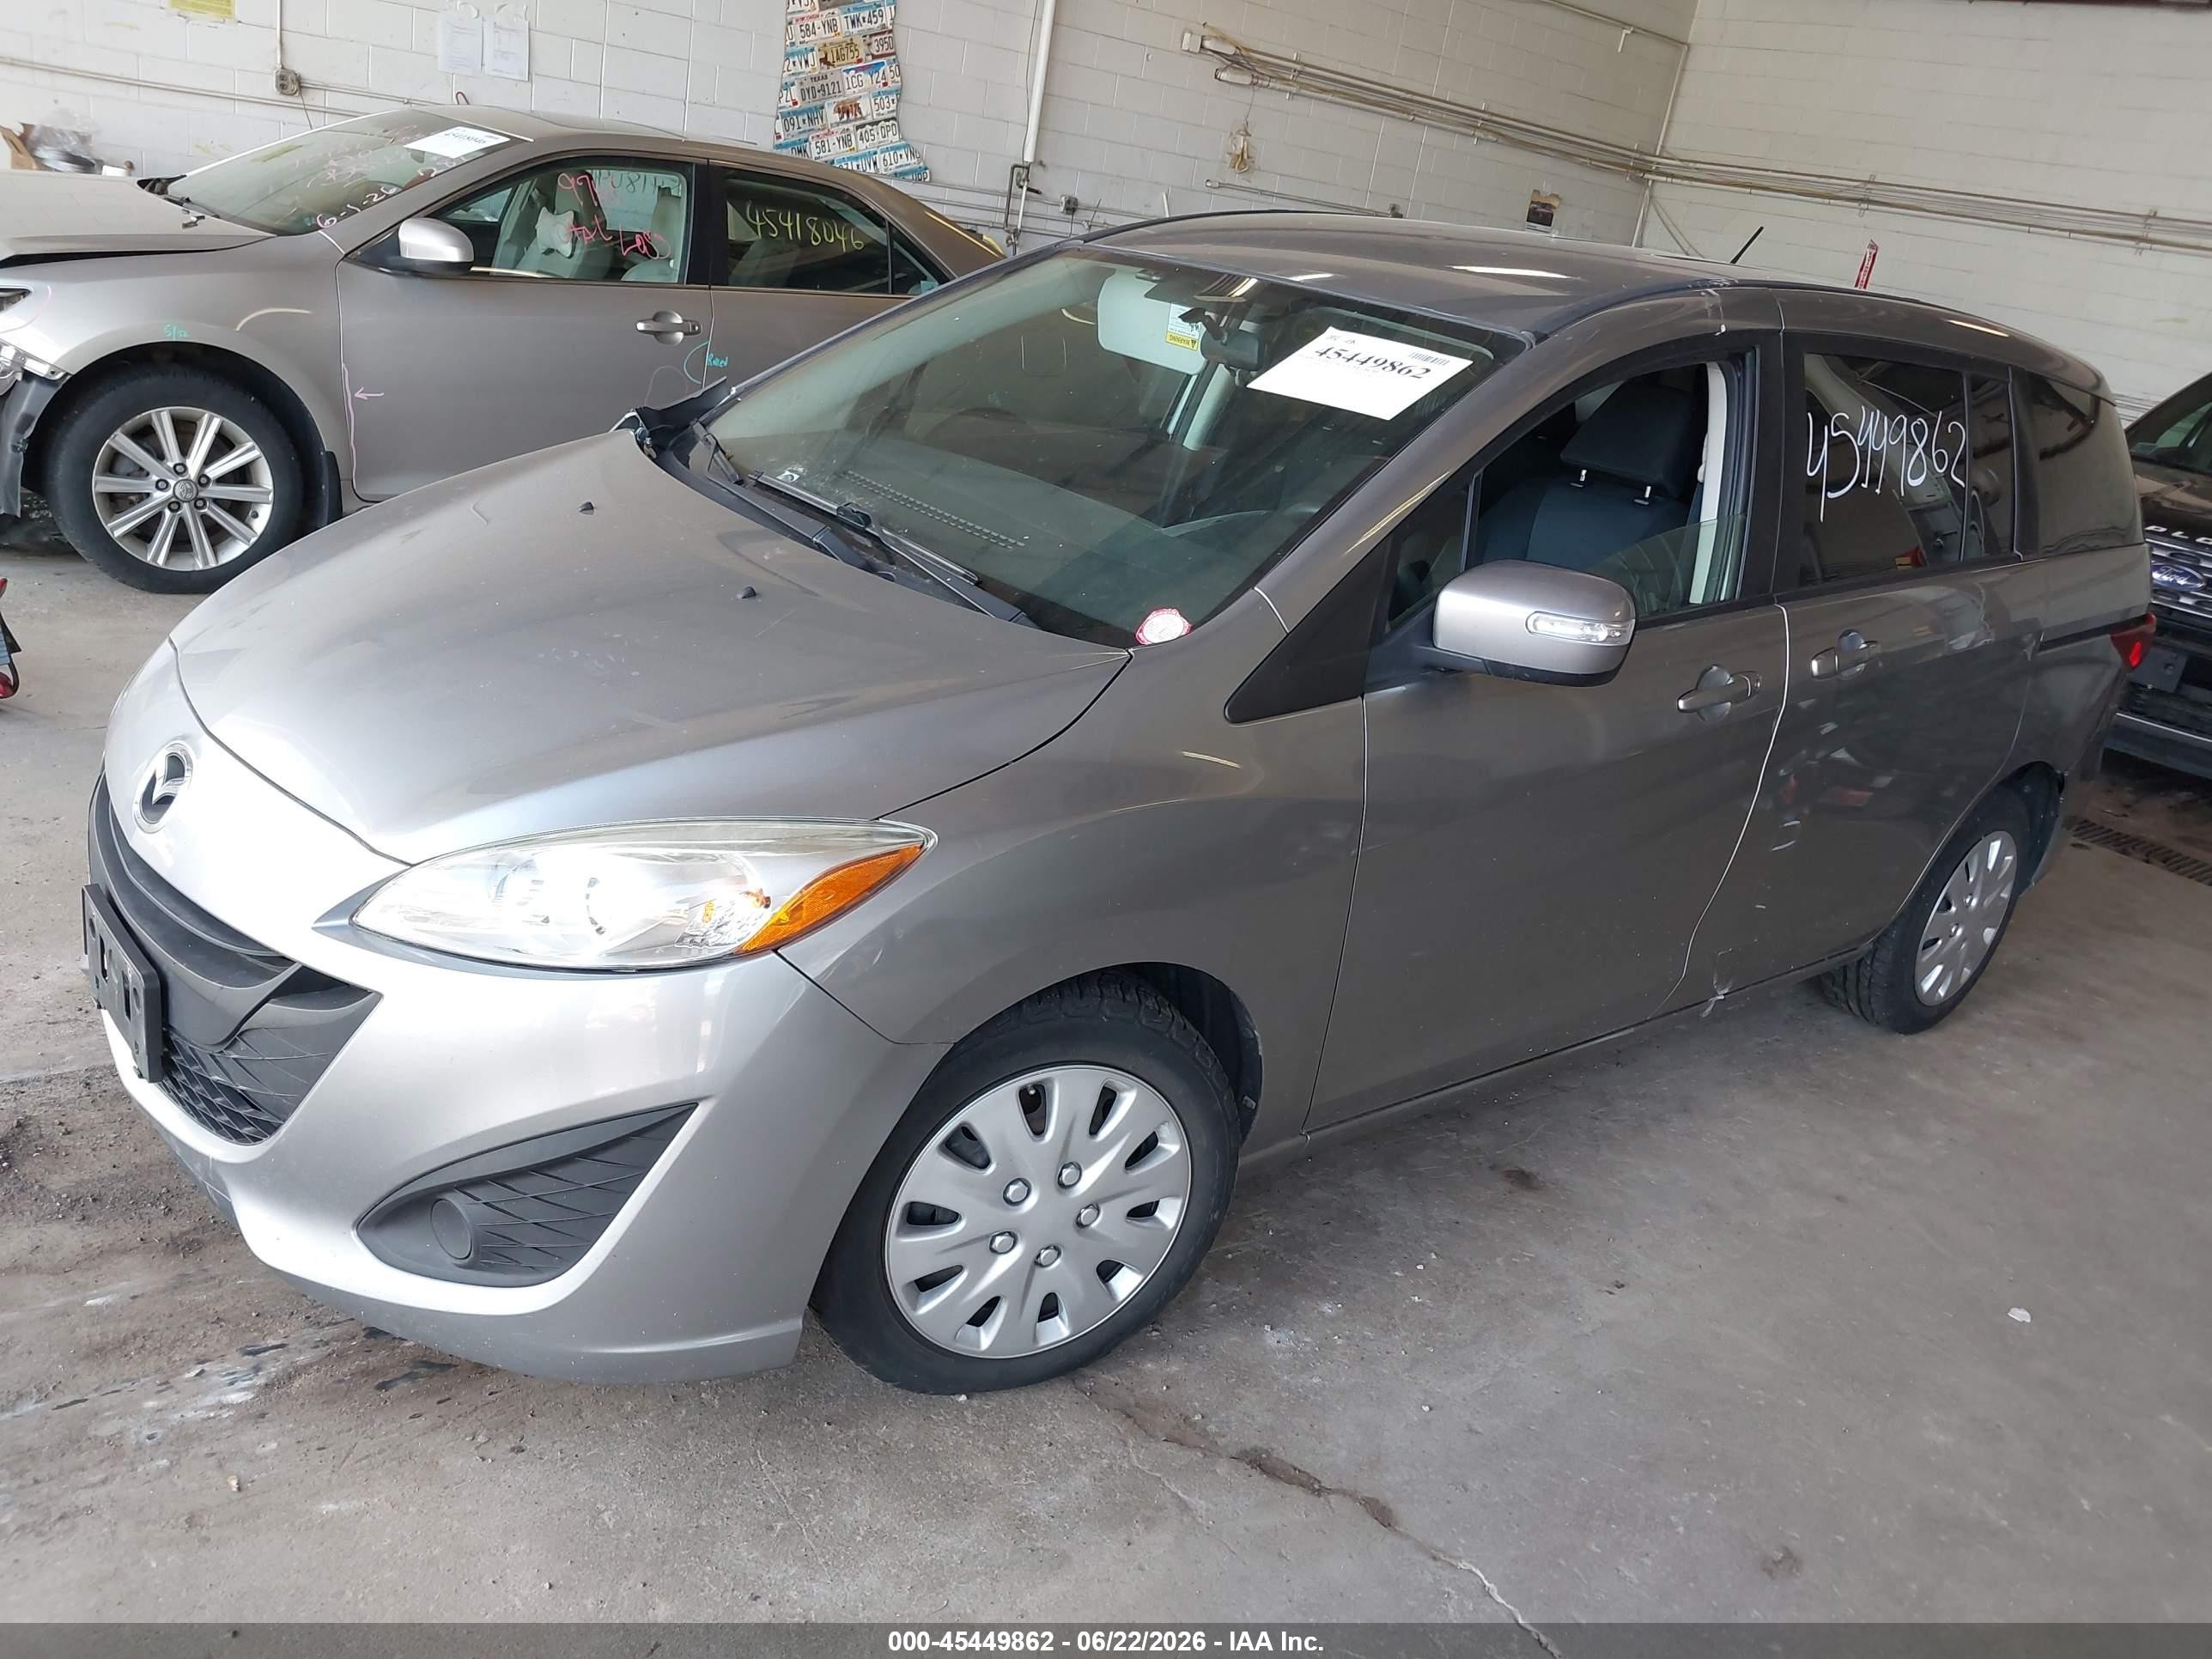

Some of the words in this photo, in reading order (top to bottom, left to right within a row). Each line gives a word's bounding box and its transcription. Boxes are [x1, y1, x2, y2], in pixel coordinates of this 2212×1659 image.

[810, 75, 829, 83] TEXAS
[746, 200, 864, 253] 45418046
[1315, 346, 1431, 379] 45449862
[1807, 405, 1965, 522] 45449862
